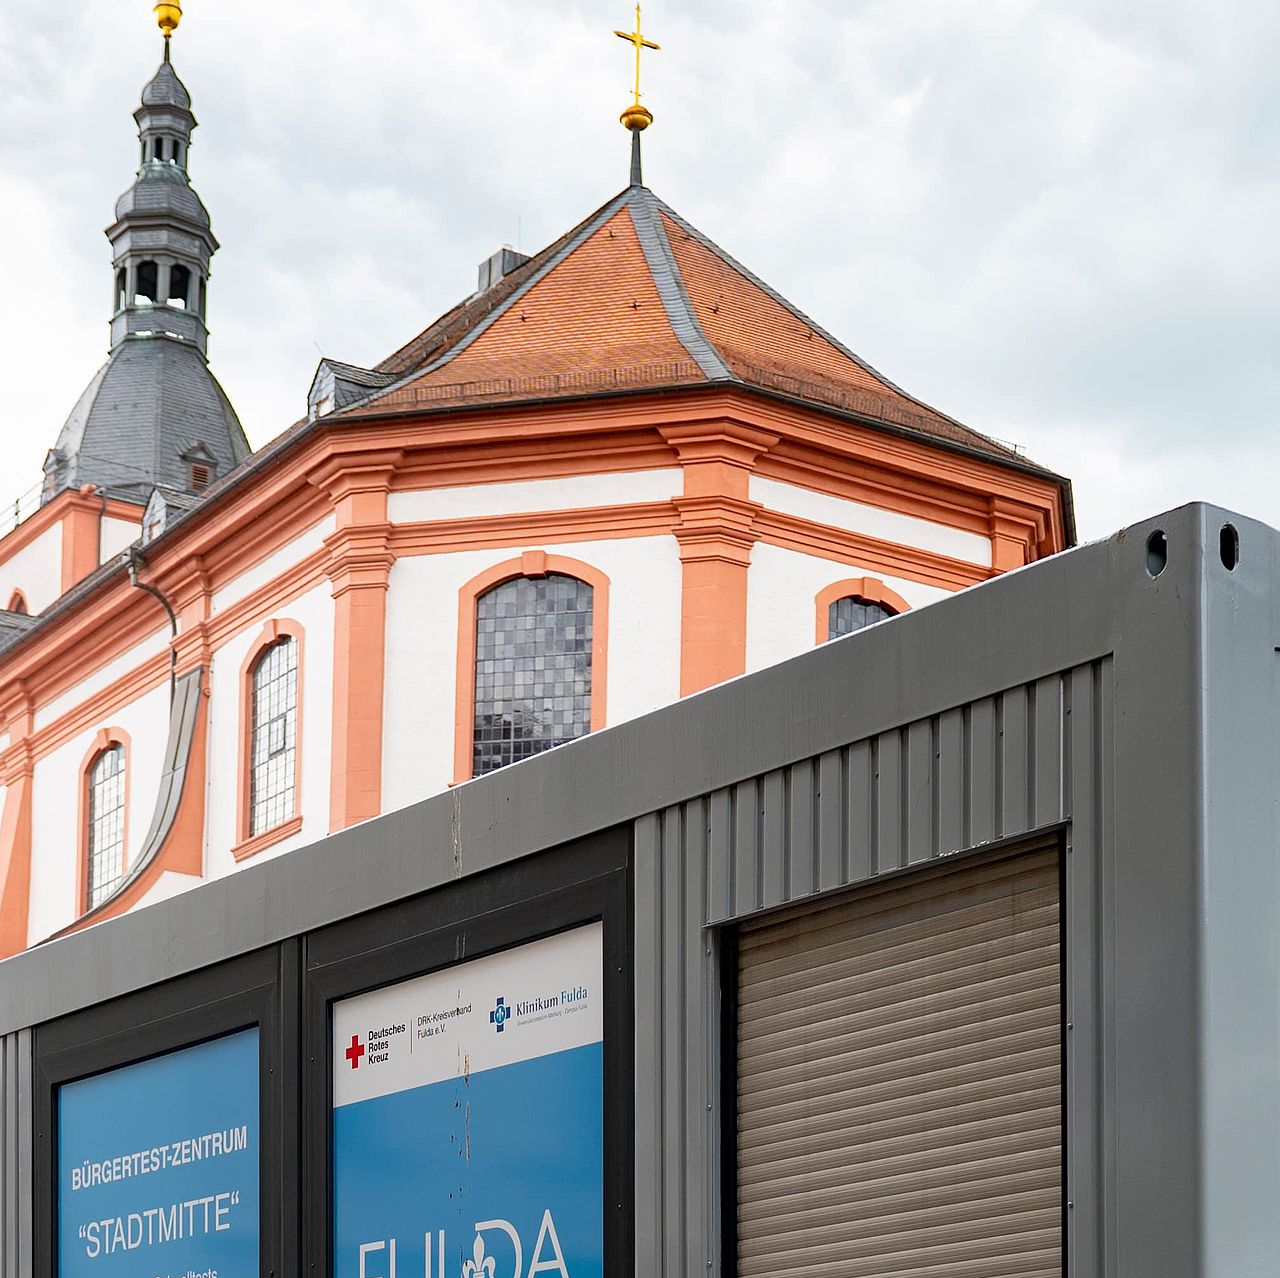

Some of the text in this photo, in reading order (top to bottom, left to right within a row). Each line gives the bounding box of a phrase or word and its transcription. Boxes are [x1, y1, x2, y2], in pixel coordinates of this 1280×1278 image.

[516, 987, 588, 1017] Klinikum Fulda
[417, 1004, 472, 1027] DRK-Kreisverband
[368, 1023, 406, 1041] Deutsches
[417, 1027, 434, 1039] Fulda
[368, 1040, 389, 1053] Rotes
[368, 1053, 389, 1065] Kreuz
[72, 1125, 247, 1191] BÜRGERTEST-ZENTRUM
